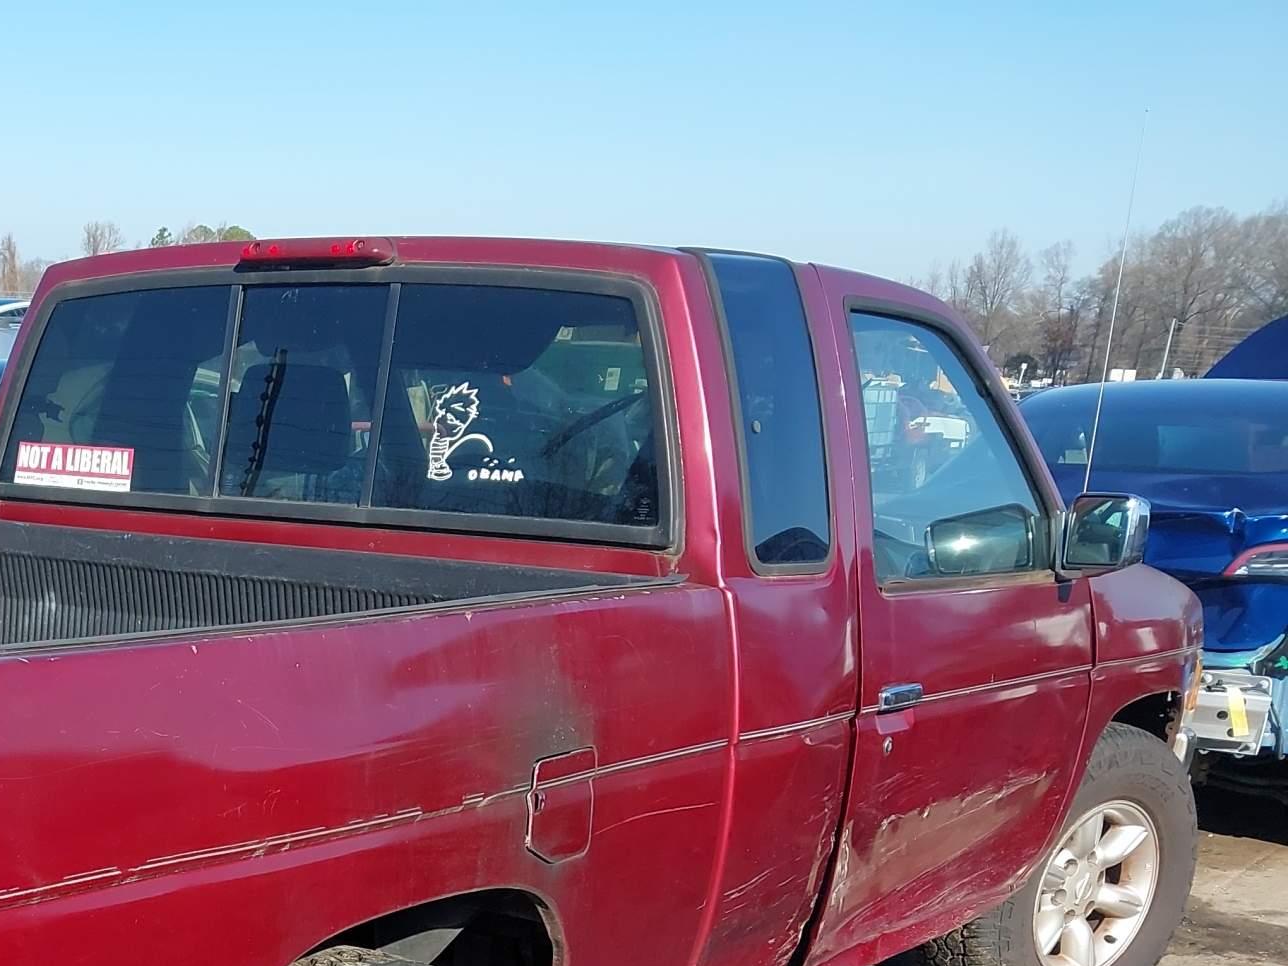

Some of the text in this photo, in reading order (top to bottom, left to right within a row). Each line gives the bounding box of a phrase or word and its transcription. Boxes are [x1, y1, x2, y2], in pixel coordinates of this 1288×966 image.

[17, 445, 130, 476] NOT A LIBERAL
